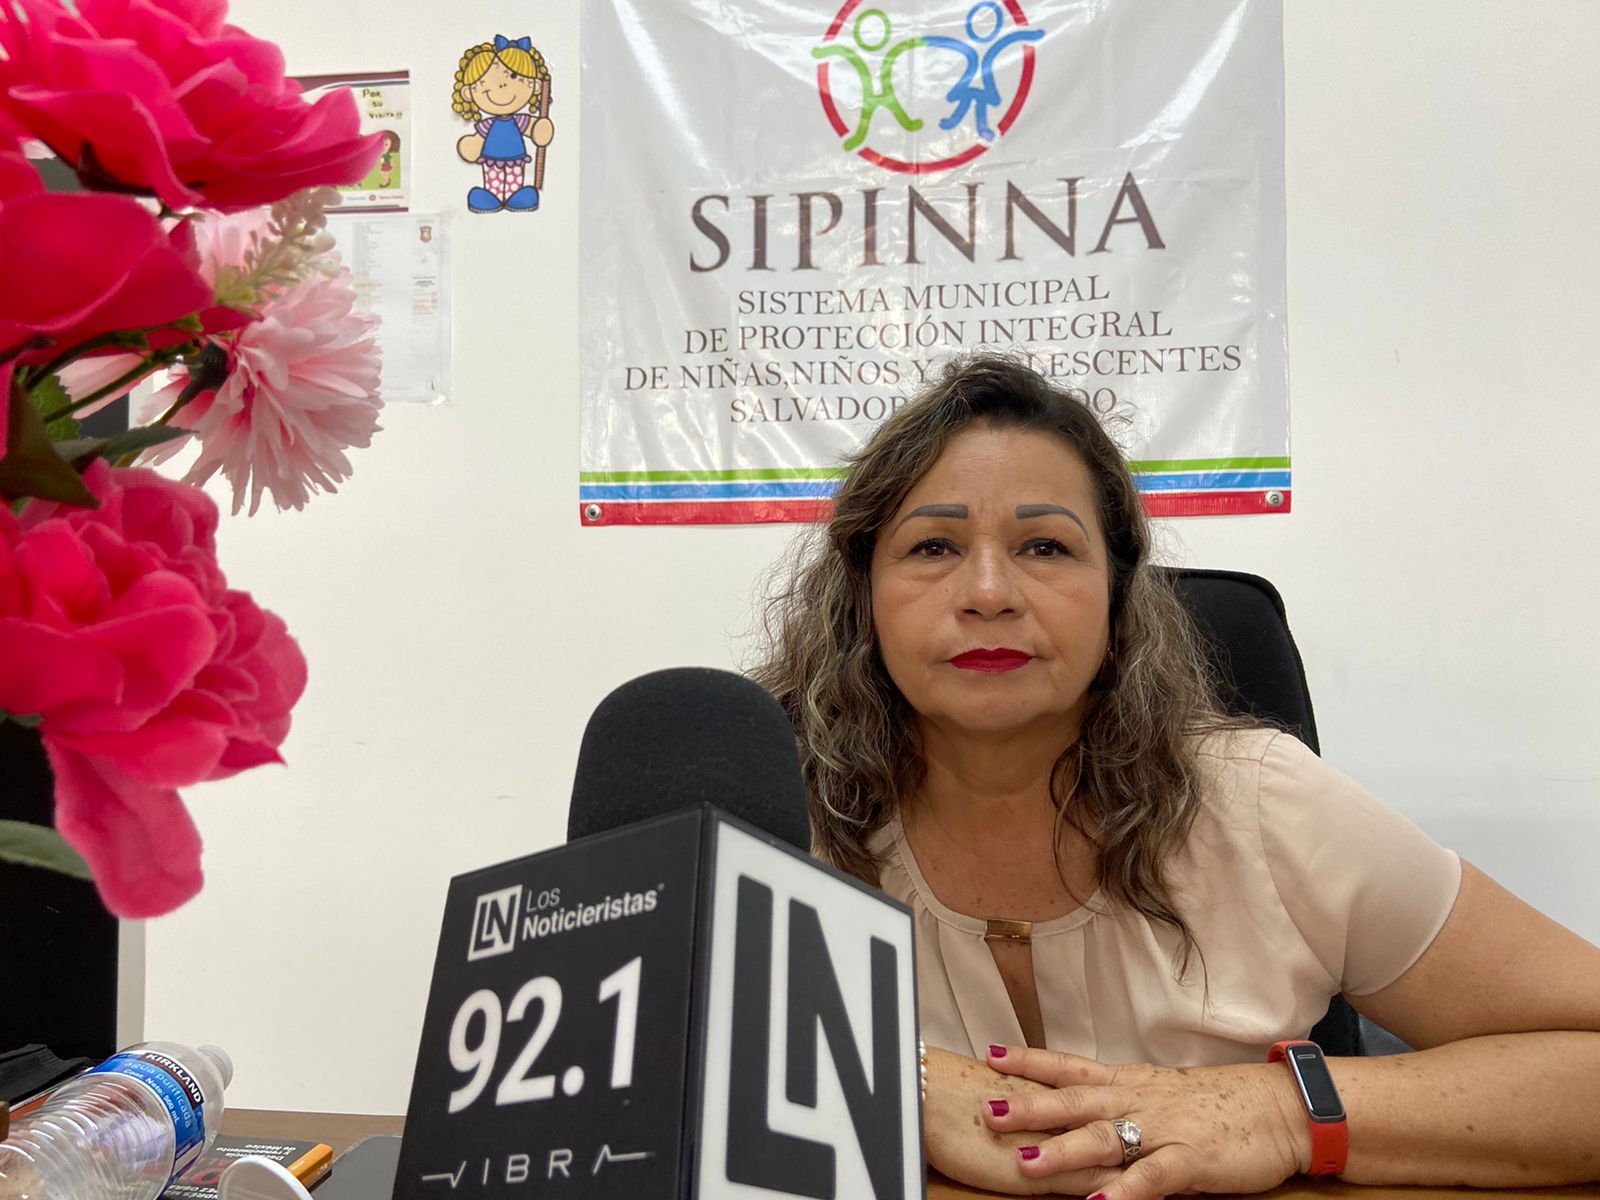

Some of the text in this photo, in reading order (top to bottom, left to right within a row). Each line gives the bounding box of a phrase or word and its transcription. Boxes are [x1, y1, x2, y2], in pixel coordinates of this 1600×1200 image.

[689, 171, 1165, 272] SIPINNA
[738, 275, 1110, 315] SISTEMA MUNICIPAL
[684, 310, 1173, 354] DE PROTECCIÓN INTEGRAL
[624, 365, 670, 391] DE
[911, 358, 934, 384] Y
[1026, 344, 1242, 379] LESCENTES
[522, 889, 658, 941] Noticieristas
[448, 956, 642, 1115] 92.1
[125, 1062, 192, 1128] agua purificada
[146, 1053, 202, 1103] KIRKLAND
[163, 1096, 174, 1110] 500
